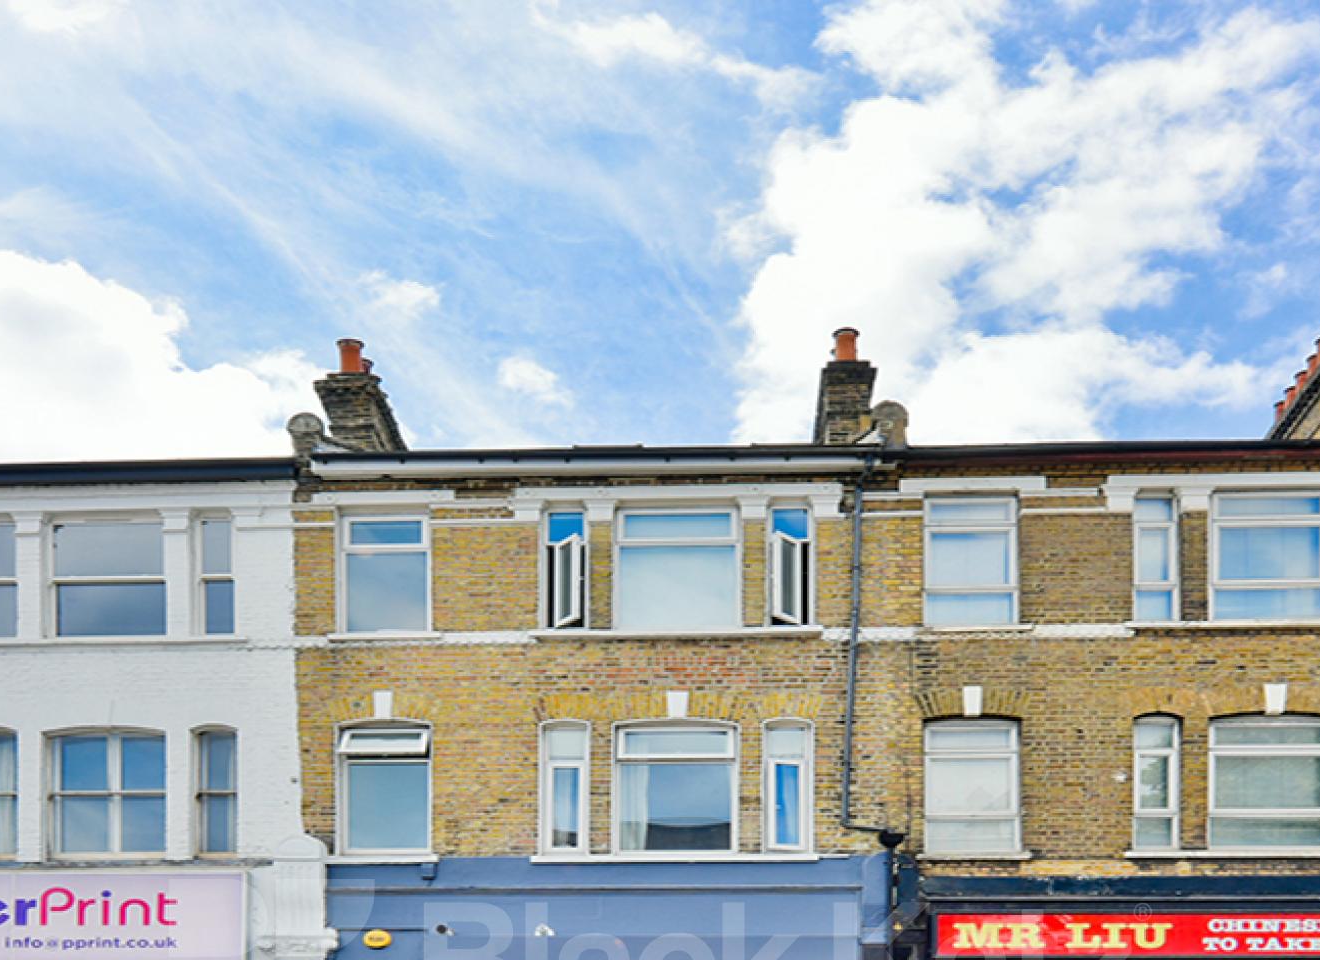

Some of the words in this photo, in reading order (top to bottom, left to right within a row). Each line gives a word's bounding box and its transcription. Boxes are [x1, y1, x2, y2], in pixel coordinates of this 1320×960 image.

[952, 922, 1047, 949] MR
[1066, 922, 1173, 949] LIU
[1202, 937, 1239, 951] TO
